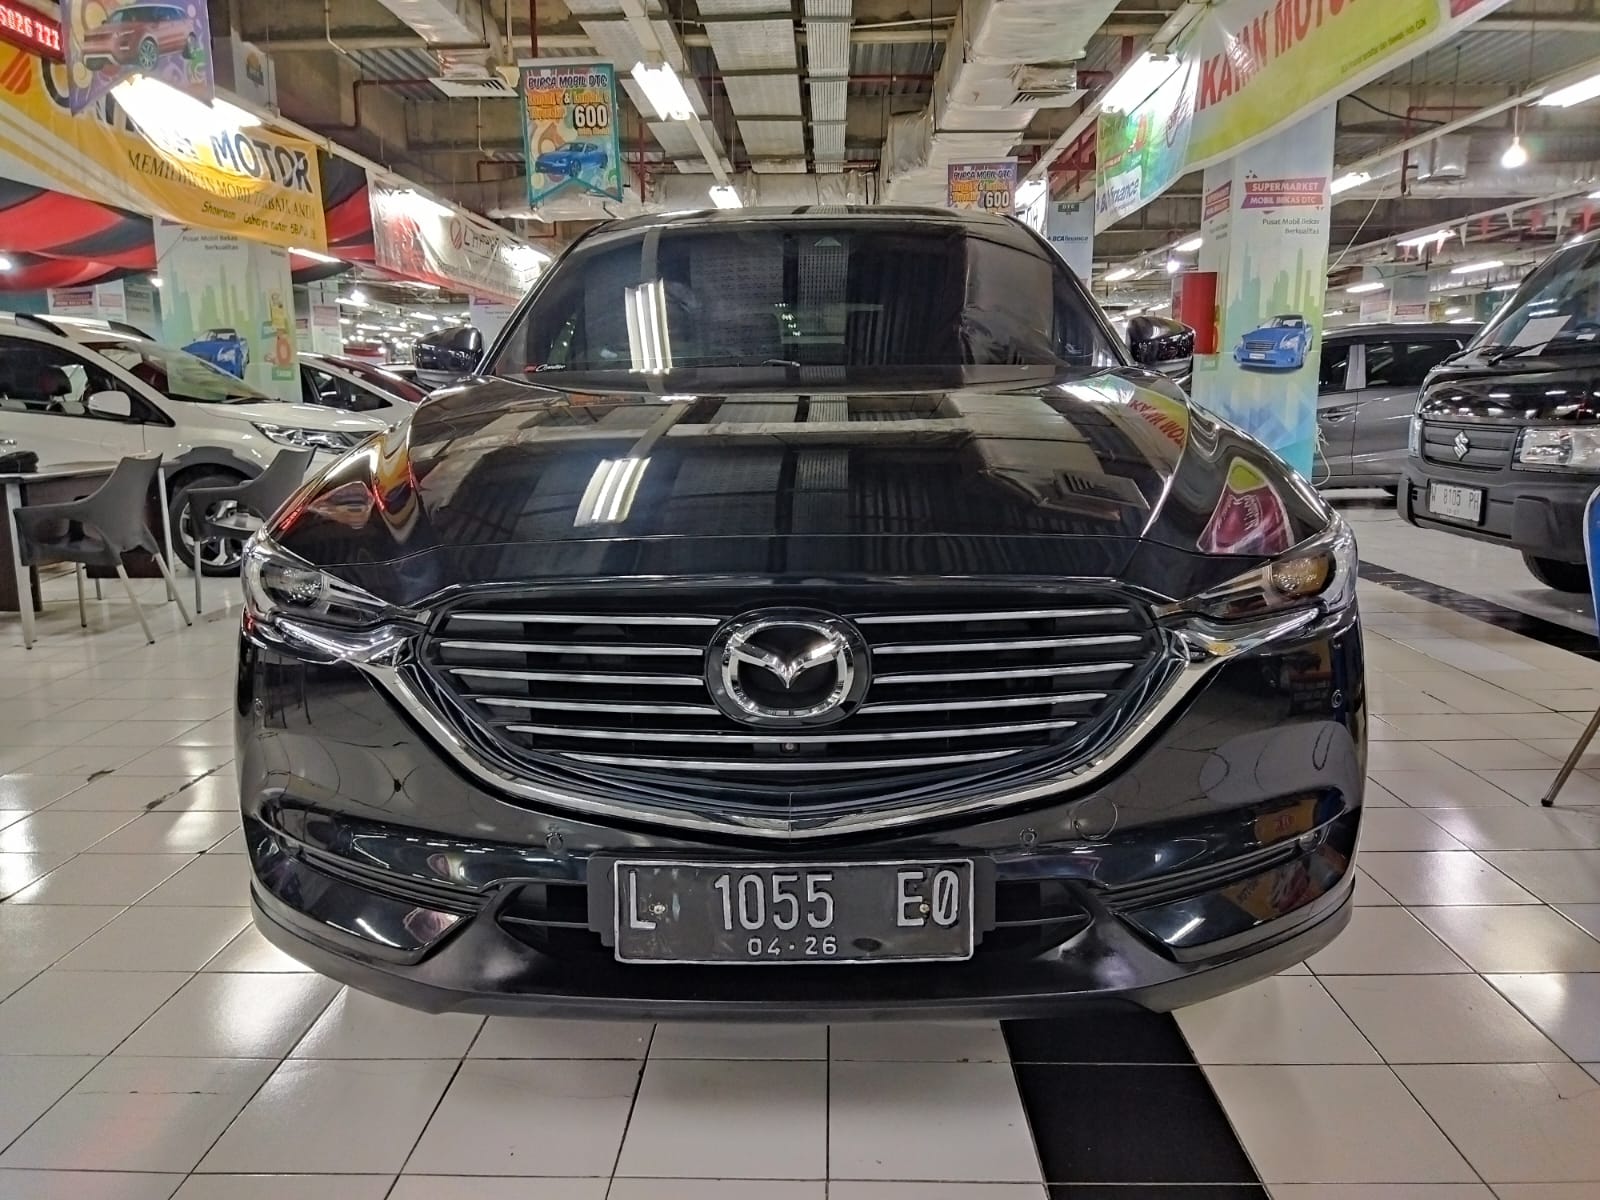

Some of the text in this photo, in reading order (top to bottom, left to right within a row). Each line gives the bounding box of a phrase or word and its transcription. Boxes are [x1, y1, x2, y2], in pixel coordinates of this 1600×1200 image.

[559, 75, 586, 89] MOBIL
[573, 104, 608, 128] 600
[209, 129, 313, 194] MOTOR
[1252, 181, 1318, 192] SUPERMARKET
[985, 191, 1009, 208] 600
[1249, 195, 1275, 204] MOBIL
[1300, 194, 1316, 204] DTC
[1282, 217, 1300, 225] Mobil
[629, 870, 657, 930] L
[714, 872, 835, 931] 1055
